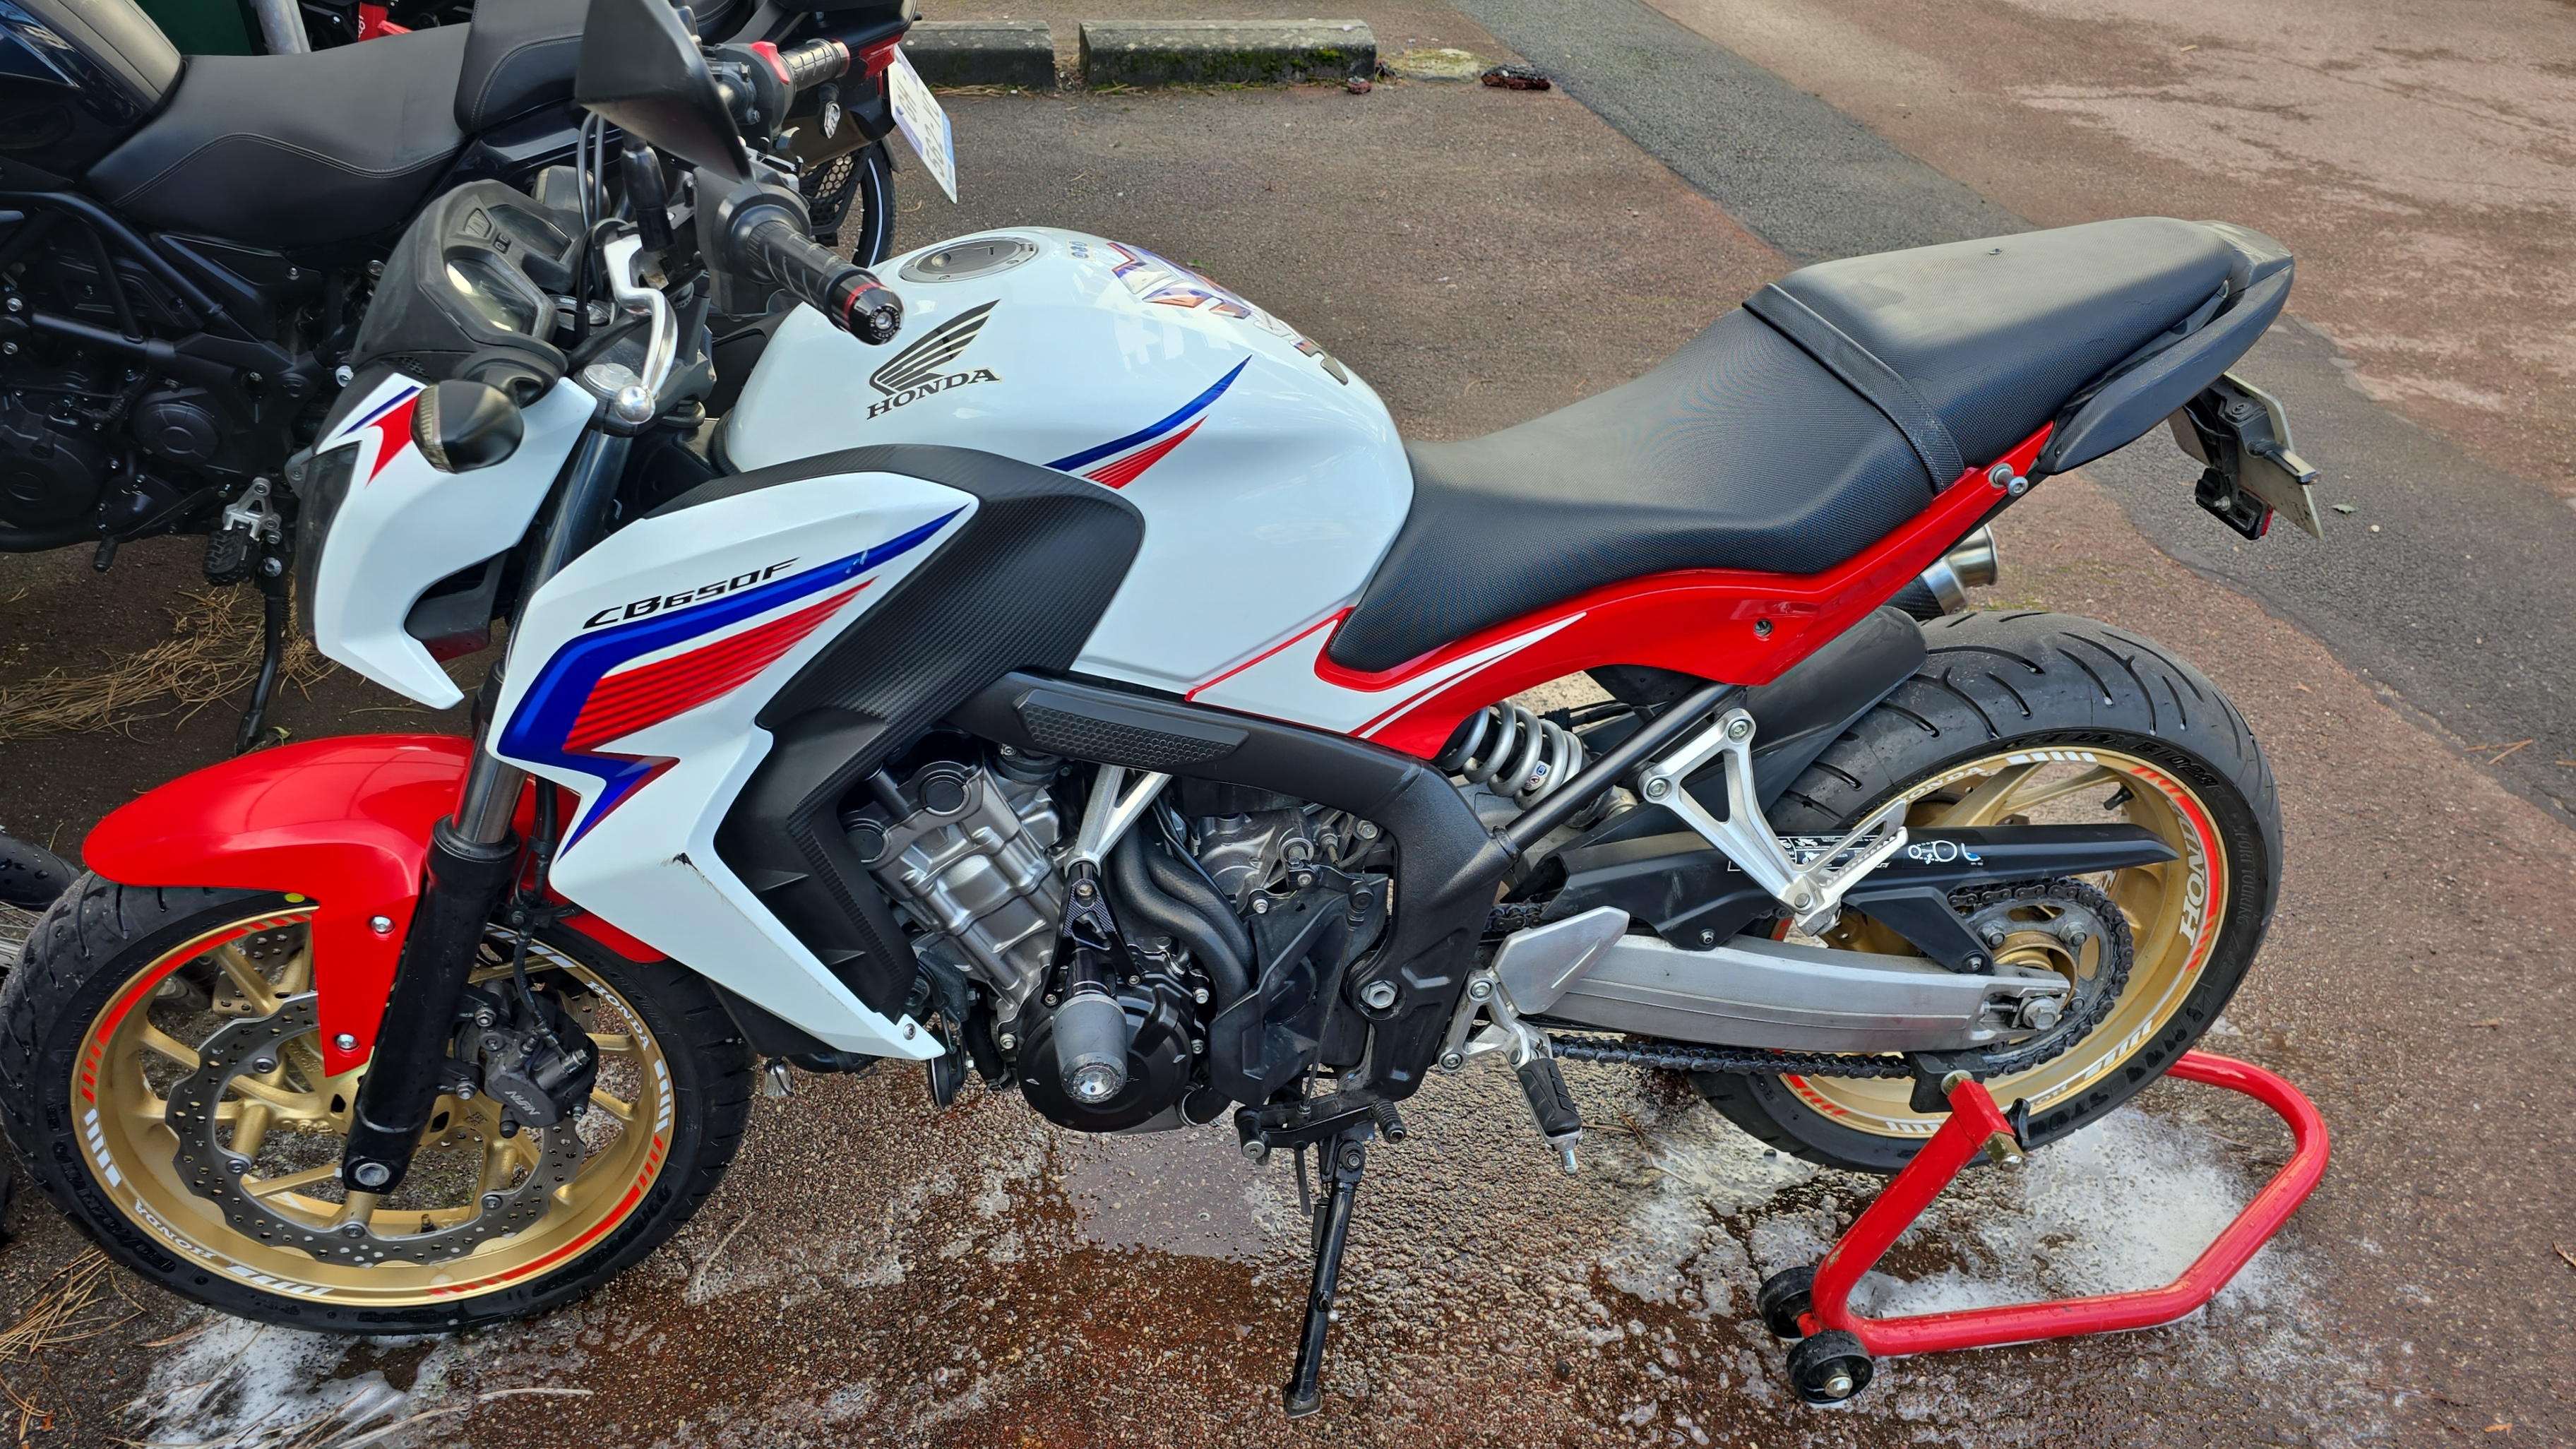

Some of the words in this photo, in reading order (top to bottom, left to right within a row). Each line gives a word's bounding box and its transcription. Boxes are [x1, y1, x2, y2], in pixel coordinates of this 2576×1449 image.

[866, 369, 1000, 420] HONDA
[582, 556, 801, 629] CB650F
[1904, 766, 1986, 804] ONDA
[2231, 824, 2255, 864] SPORT
[2236, 869, 2255, 926] TOURING
[584, 980, 650, 1051] HONDA
[2027, 991, 2211, 1136] BRIDGESTON
[504, 1090, 541, 1115] NISSIN
[135, 1198, 216, 1259] HONDA
